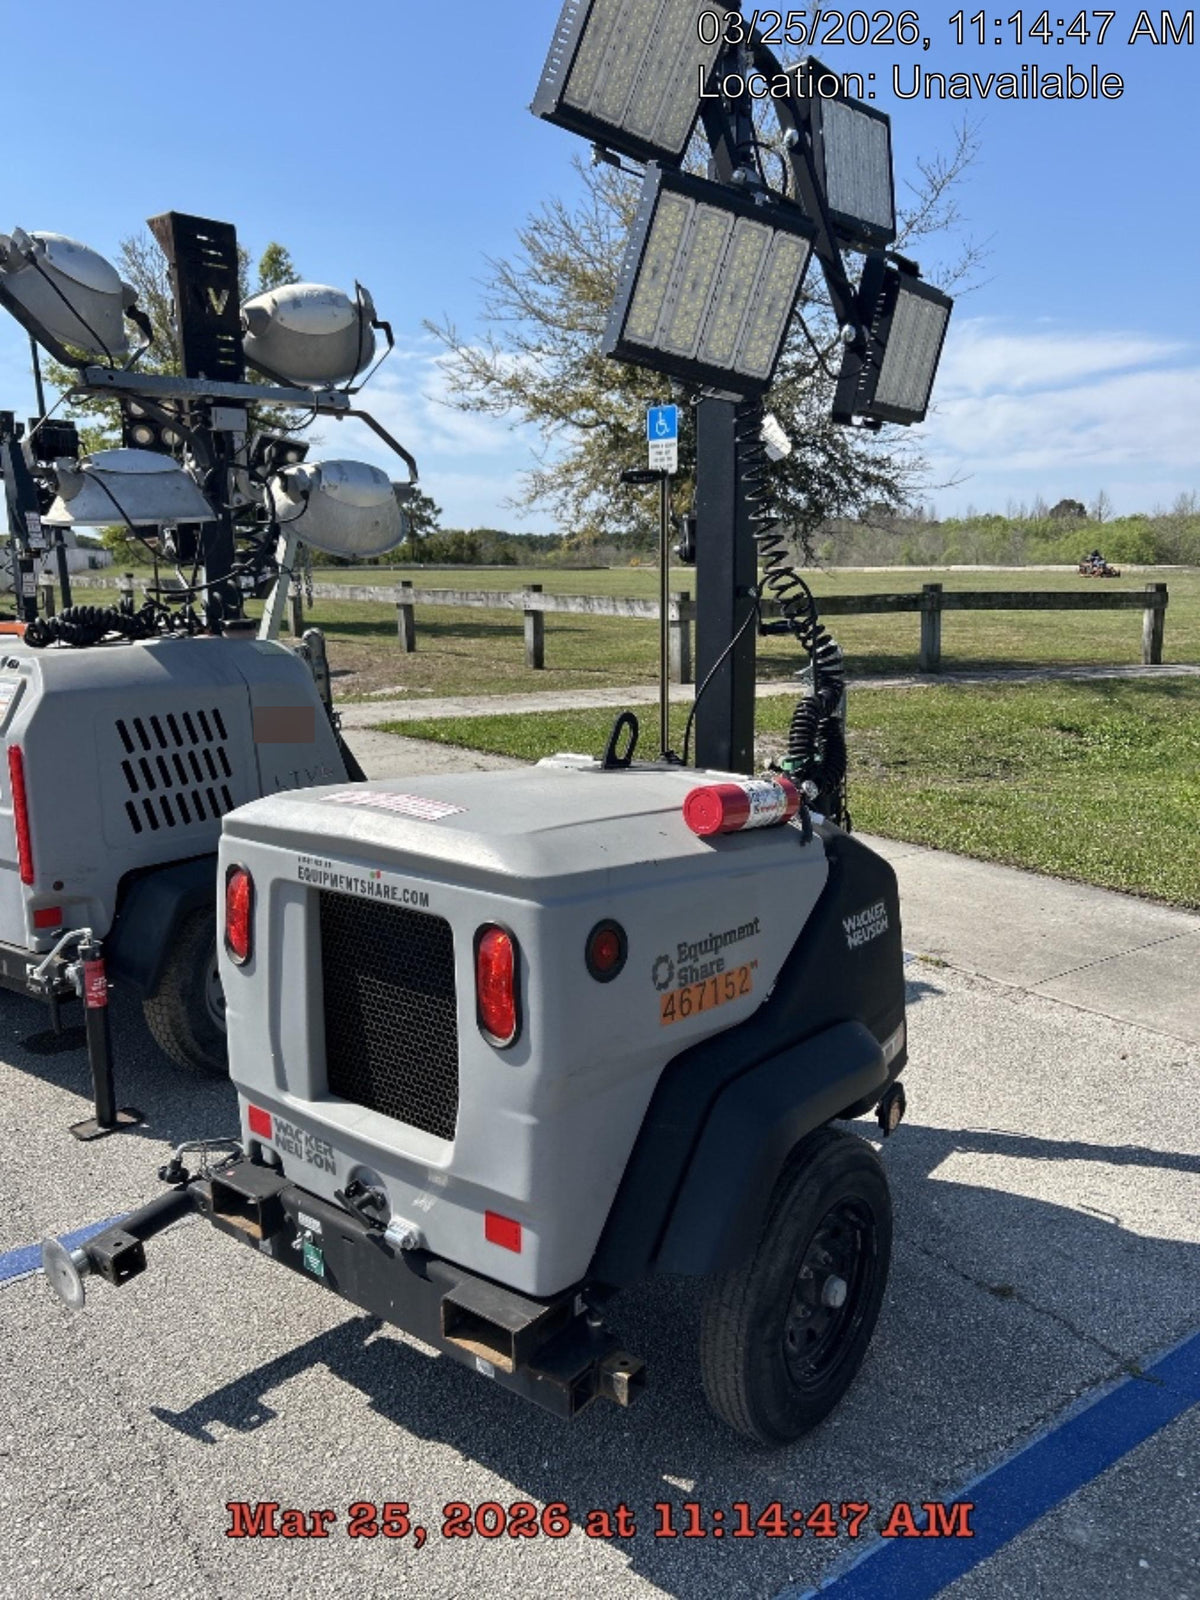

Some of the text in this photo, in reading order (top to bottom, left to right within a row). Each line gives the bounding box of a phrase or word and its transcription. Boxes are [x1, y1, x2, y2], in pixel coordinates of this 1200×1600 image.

[298, 866, 430, 907] EQUIPMENTSHARE.COM
[842, 902, 886, 934] WACKER
[846, 915, 888, 950] NEUSON
[677, 917, 761, 964] Equipment
[677, 957, 725, 987] Share
[662, 966, 750, 1021] 467152
[274, 1117, 335, 1159] WACKER
[275, 1133, 336, 1176] NEUSON
